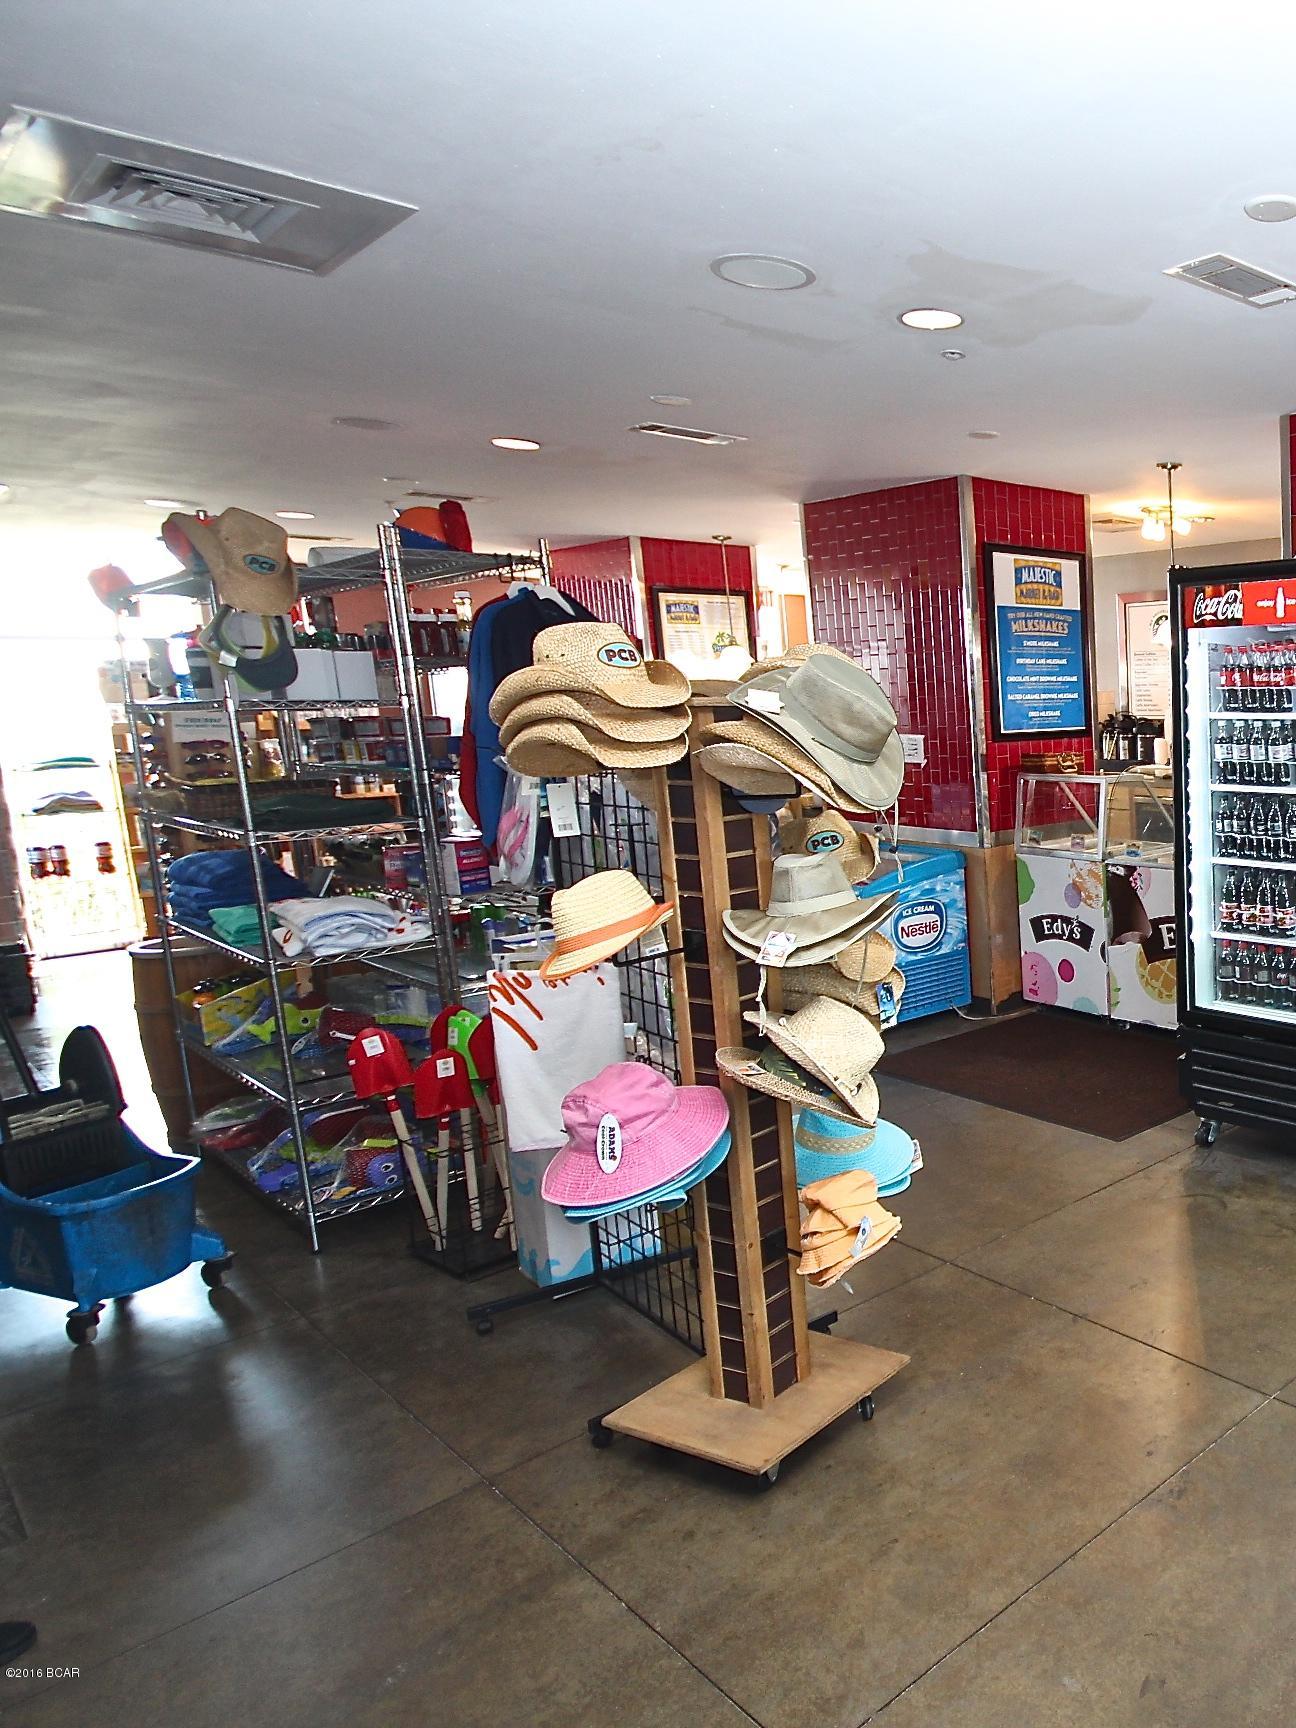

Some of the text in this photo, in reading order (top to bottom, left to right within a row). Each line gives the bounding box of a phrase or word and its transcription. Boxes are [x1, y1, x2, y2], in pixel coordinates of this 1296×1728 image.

[1021, 566, 1057, 586] MAJESTIC
[1256, 599, 1275, 609] enjoy
[1285, 597, 1296, 605] ice
[1011, 619, 1069, 634] MILKSHAKES
[604, 648, 638, 663] PCB
[811, 834, 840, 851] PCB
[902, 904, 935, 917] ICE CREAM
[1042, 915, 1081, 940] Edy's
